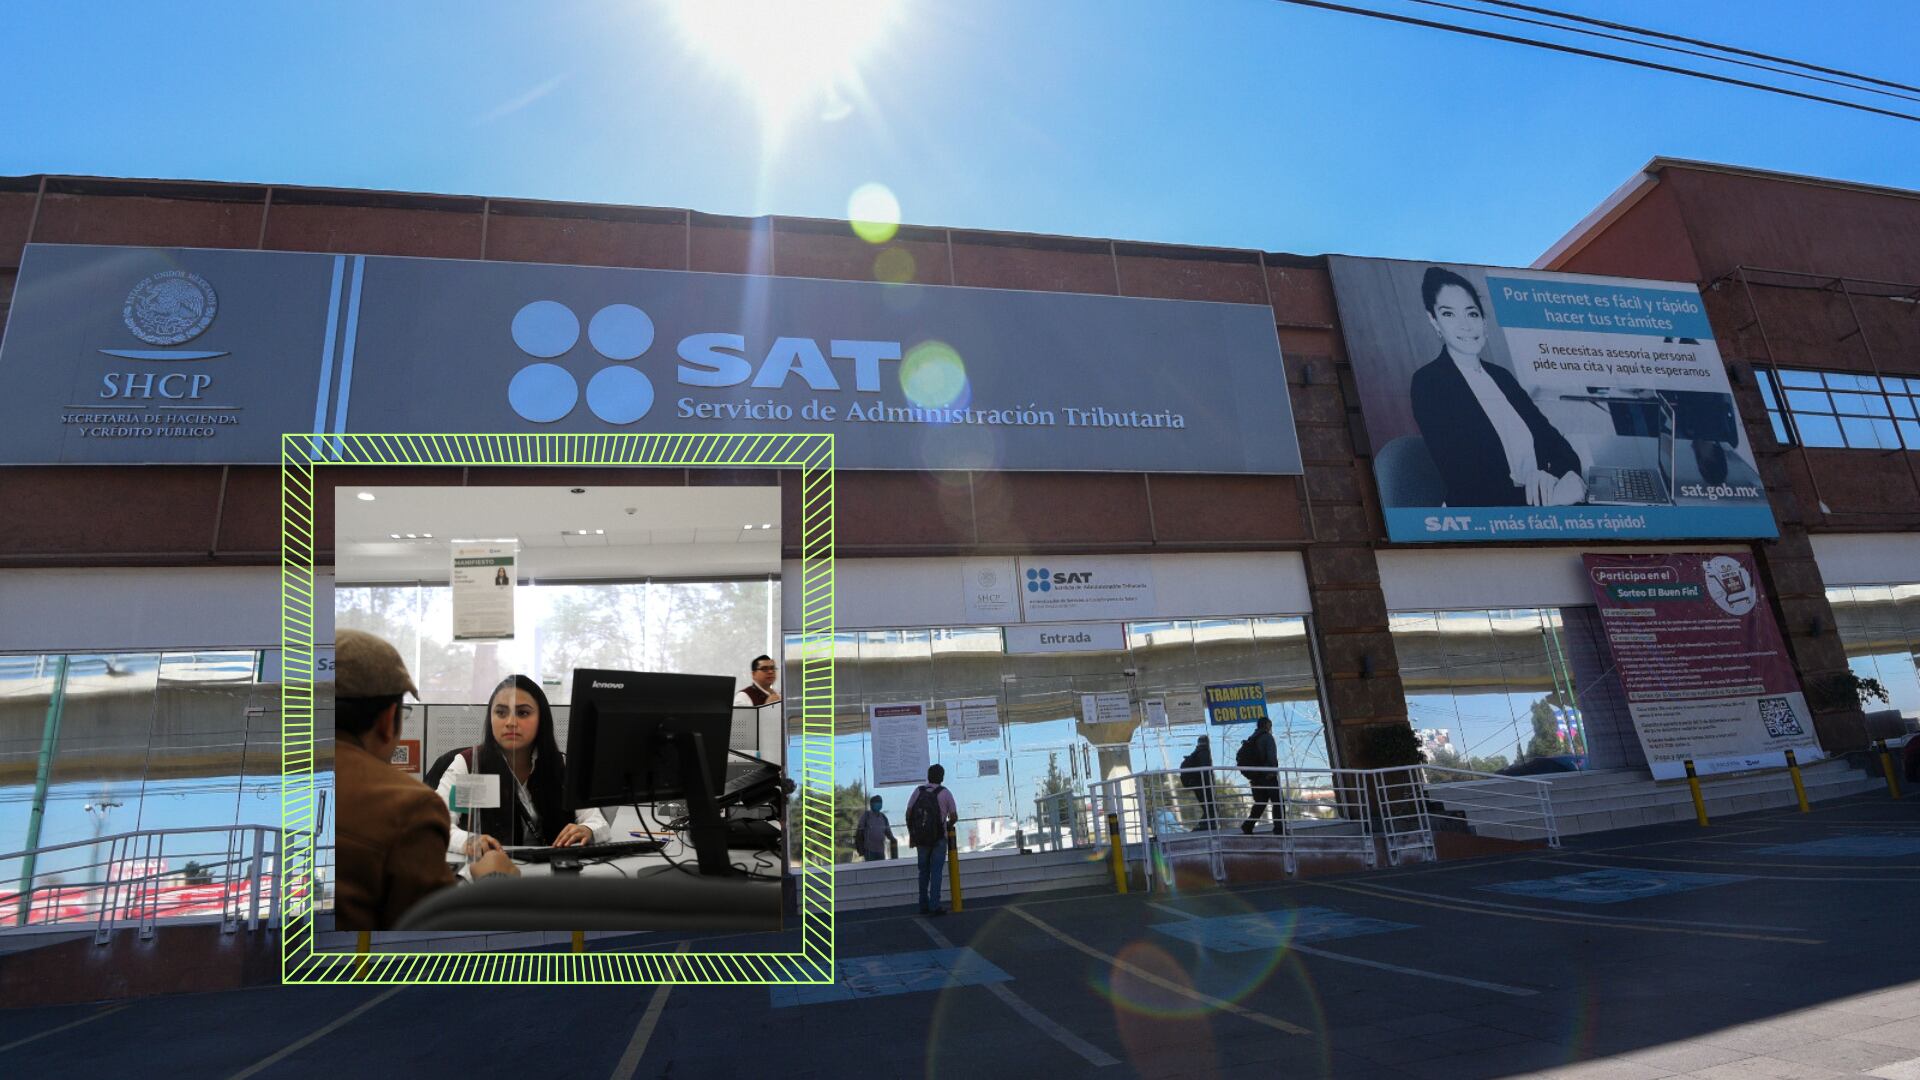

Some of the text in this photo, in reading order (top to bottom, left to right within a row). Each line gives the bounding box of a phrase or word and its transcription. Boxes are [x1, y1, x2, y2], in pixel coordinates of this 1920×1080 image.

[1503, 287, 1699, 314] Por internet es fácil y rápido
[1544, 308, 1673, 330] hacer tus trámites
[676, 332, 902, 392] SAT
[1538, 343, 1696, 365] Si necesitas asesoría personal
[1533, 358, 1711, 378] pide una cita y aquí te esperamos
[99, 372, 213, 399] SHCP
[143, 414, 161, 424] DE
[166, 415, 240, 425] HACIENDA
[677, 397, 1186, 430] Servicio de Administración Tributaria
[79, 427, 89, 437] Y
[1680, 484, 1759, 500] sat.gob.mx
[1424, 516, 1472, 532] SAT
[1565, 513, 1595, 530] más
[1597, 513, 1646, 533] rápido!
[1053, 572, 1093, 584] SAT
[1661, 571, 1670, 580] el
[1617, 588, 1647, 598] Sorteo
[1648, 588, 1657, 597] El
[1658, 588, 1681, 597] Buen
[1040, 632, 1092, 645] Entrada
[592, 680, 625, 689] lenovo
[1207, 685, 1263, 703] TRAMITES
[1213, 704, 1265, 721] CON CITA
